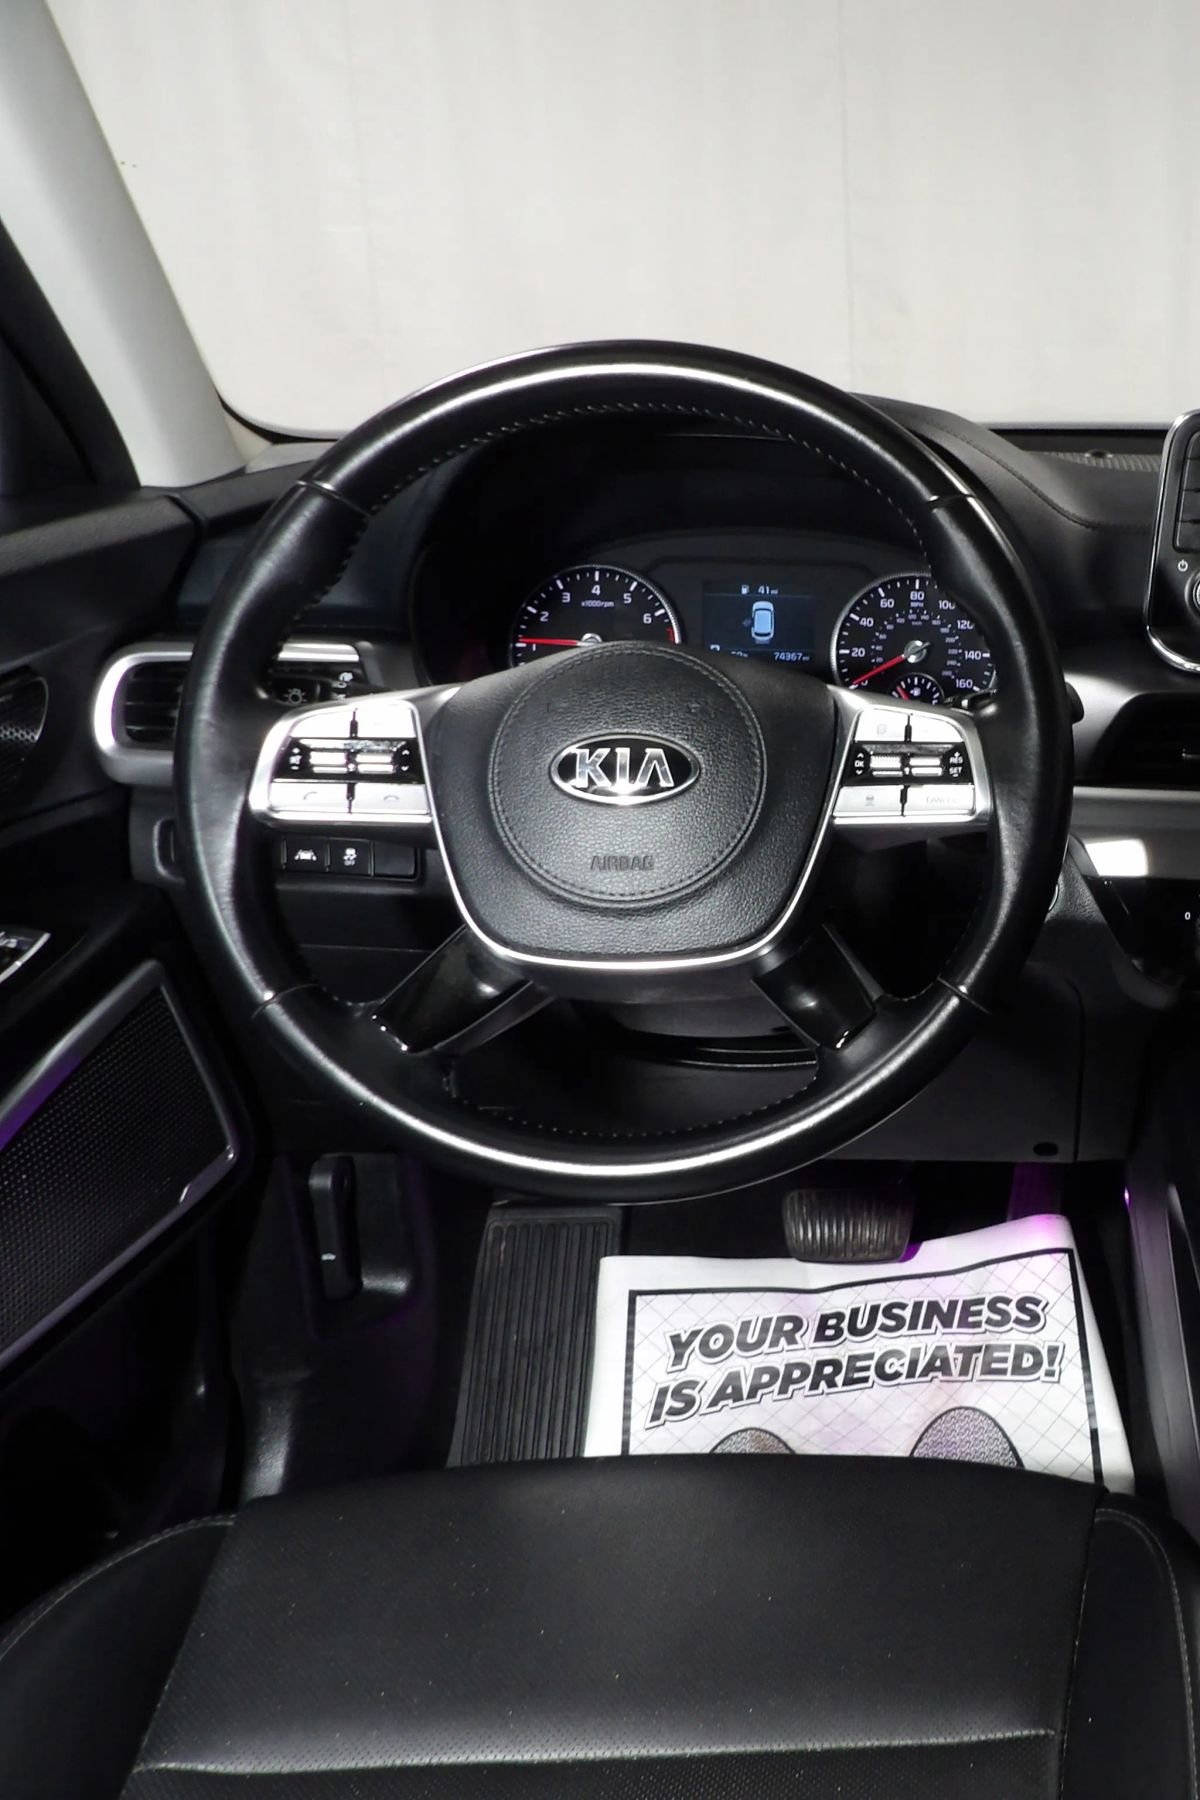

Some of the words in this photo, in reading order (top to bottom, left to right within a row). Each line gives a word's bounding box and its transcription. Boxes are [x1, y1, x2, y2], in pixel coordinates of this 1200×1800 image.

[591, 585, 600, 595] 4
[562, 592, 571, 603] 3
[623, 593, 632, 604] 5
[910, 591, 925, 601] 80
[581, 600, 614, 608] x1000rpm
[880, 598, 894, 608] 60
[540, 611, 549, 622] 2
[643, 613, 652, 624] 6
[860, 617, 874, 627] 40
[851, 647, 865, 657] 20
[964, 650, 981, 660] 140
[956, 679, 973, 689] 160
[575, 747, 675, 788] KIA
[854, 760, 864, 768] OK
[949, 767, 962, 775] SET
[591, 855, 654, 871] AIRBAG
[667, 1312, 807, 1373] YOUR
[811, 1296, 1049, 1346] BUSINESS
[647, 1381, 704, 1427] IS
[701, 1343, 1066, 1409] APPRECIATED!
